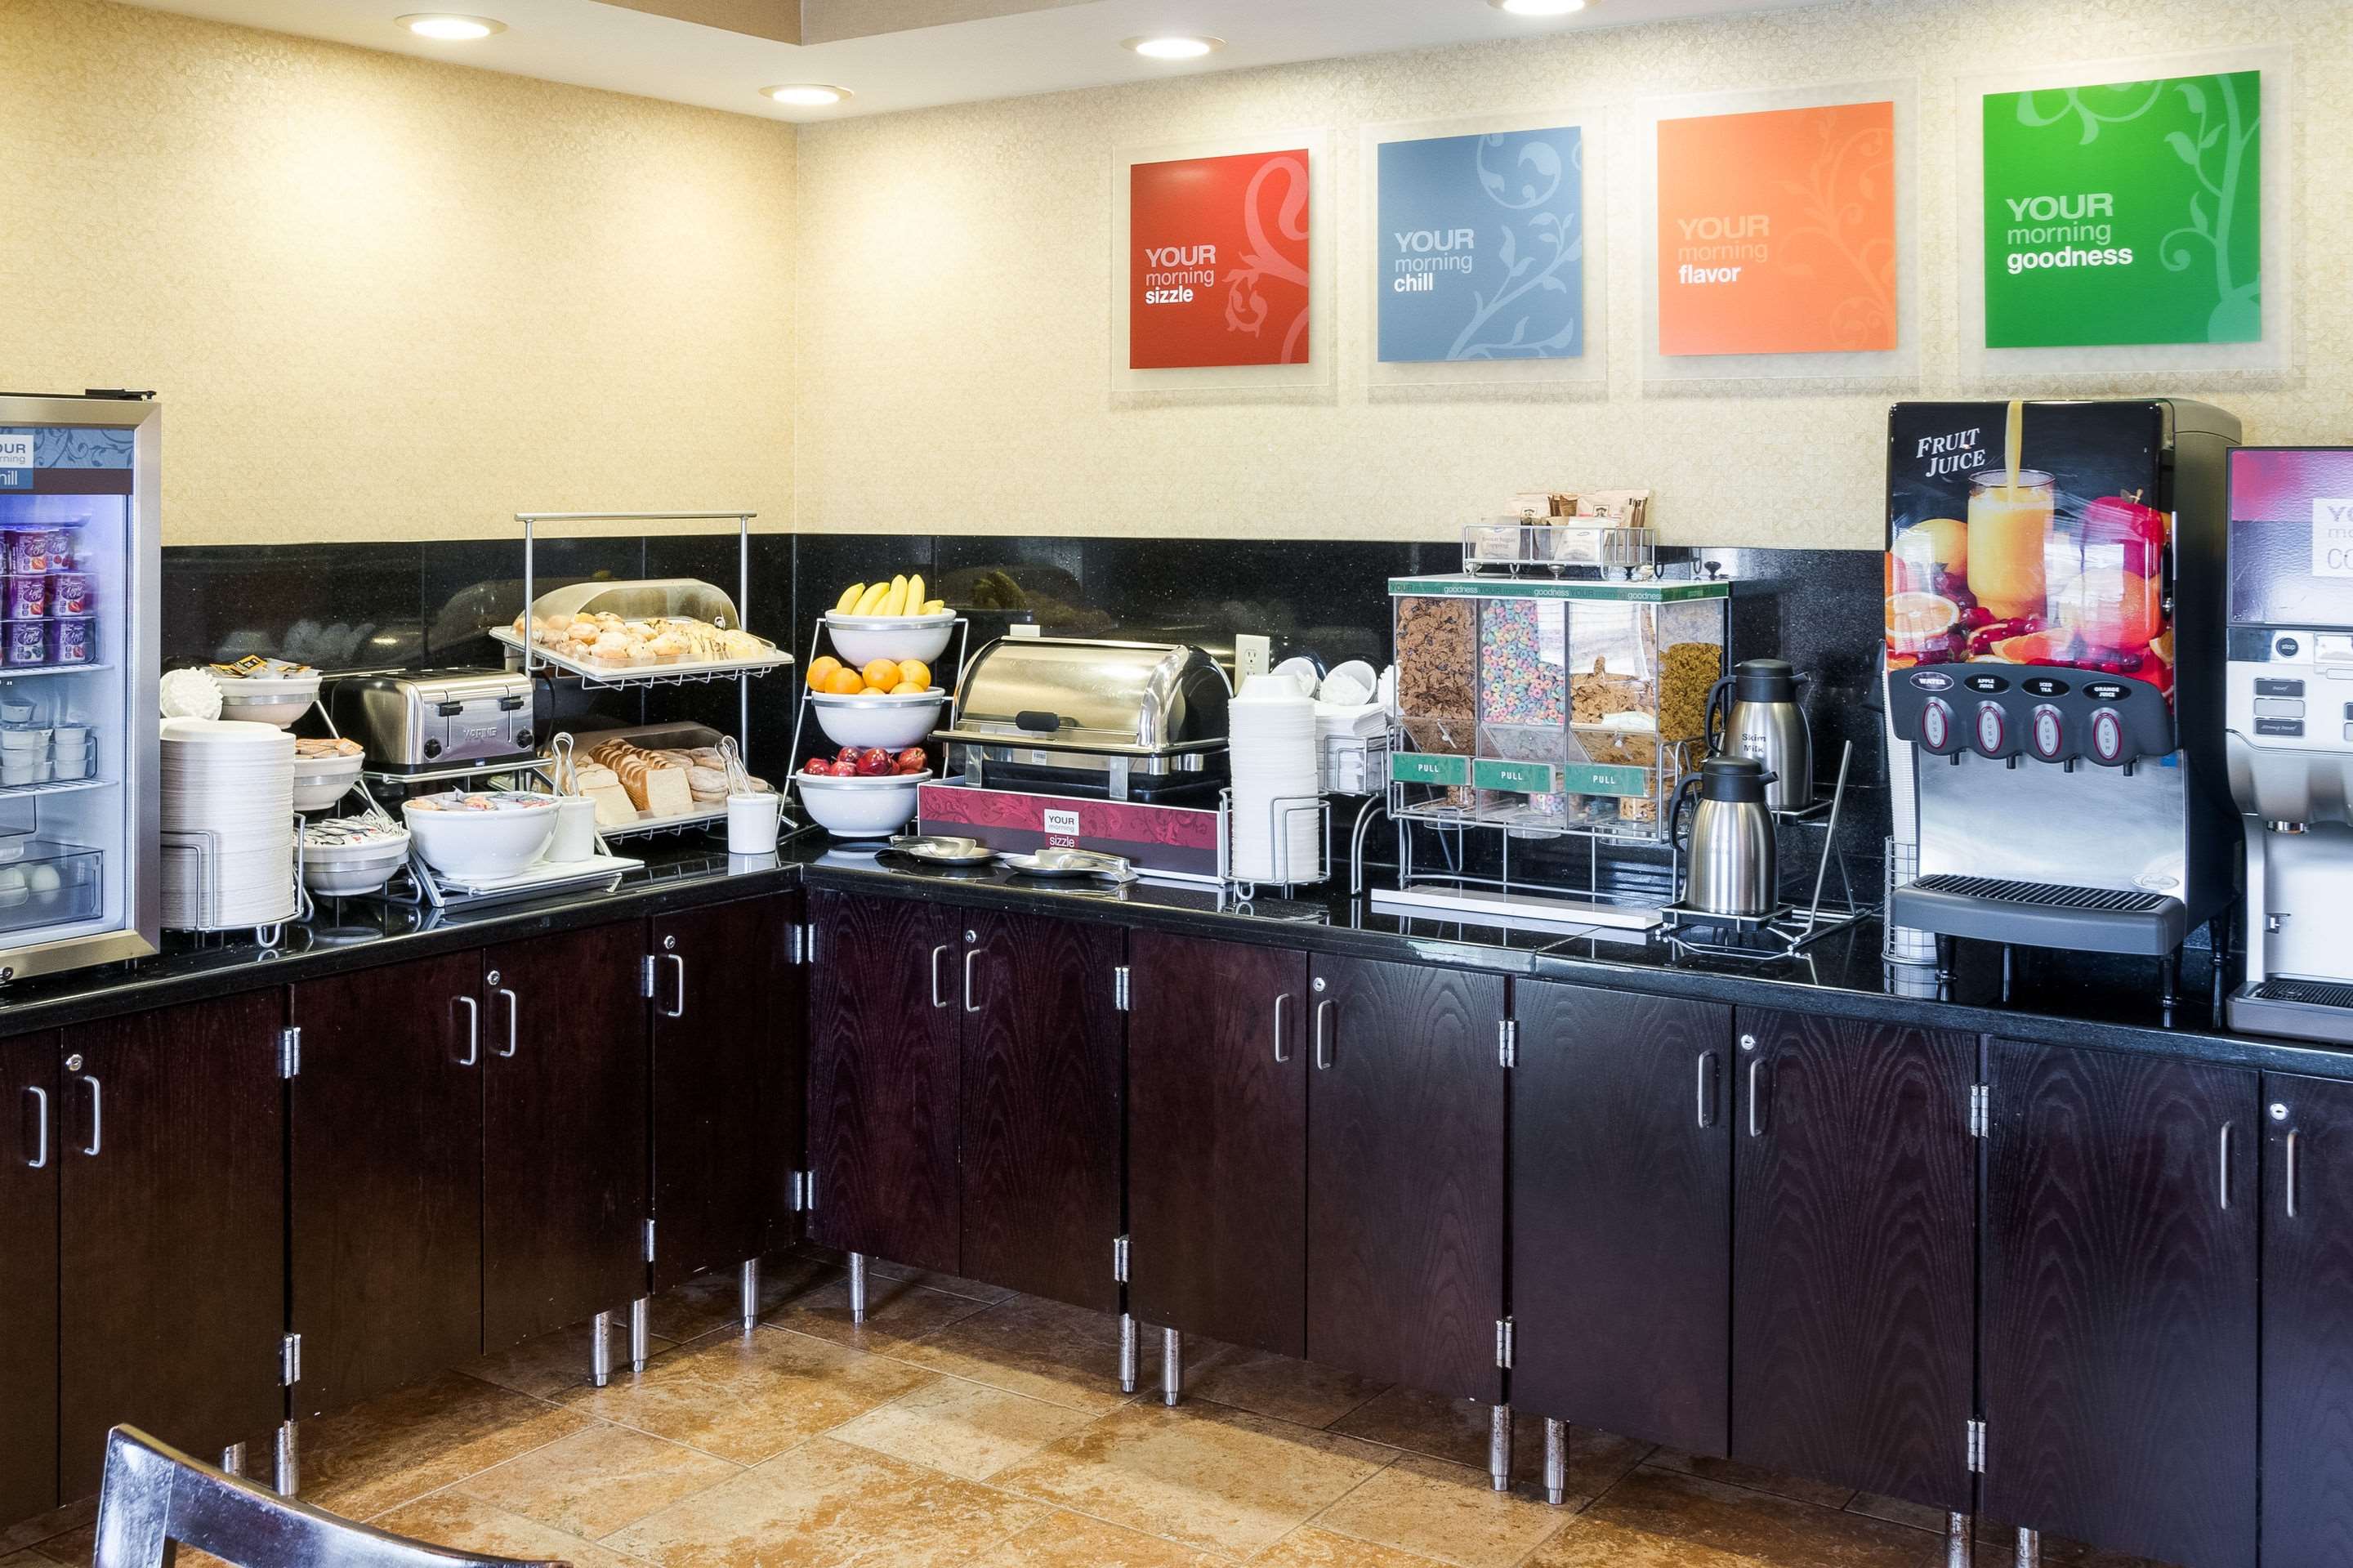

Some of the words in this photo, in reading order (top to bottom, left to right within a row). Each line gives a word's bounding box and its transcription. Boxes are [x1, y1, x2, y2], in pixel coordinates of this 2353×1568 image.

[2006, 193, 2114, 221] YOUR
[1677, 215, 1769, 240] YOUR
[2007, 221, 2110, 245] morning
[1394, 229, 1474, 252] YOUR
[1145, 244, 1216, 267] YOUR
[1679, 240, 1767, 262] morning
[2007, 246, 2133, 275] goodness
[1395, 252, 1472, 274] morning
[1145, 267, 1214, 287] morning
[1394, 272, 1433, 293] chill
[1678, 264, 1742, 284] flavor
[1145, 285, 1193, 304] sizzle
[0, 444, 25, 453] UR
[1916, 428, 1980, 458] FRUIT
[1926, 449, 1985, 477] JUICE
[2327, 506, 2353, 522] Y
[1391, 583, 1413, 592] YOUR
[1444, 584, 1478, 594] goodness
[1534, 587, 1569, 597] goodness
[1918, 677, 1946, 686] WATER
[1742, 733, 1766, 742] Skim
[1744, 744, 1764, 753] Milk
[1418, 763, 1440, 773] PULL
[1501, 771, 1523, 780] PULL
[1592, 775, 1615, 784] PULL
[1048, 815, 1075, 825] YOUR
[1049, 834, 1075, 848] sizzle
